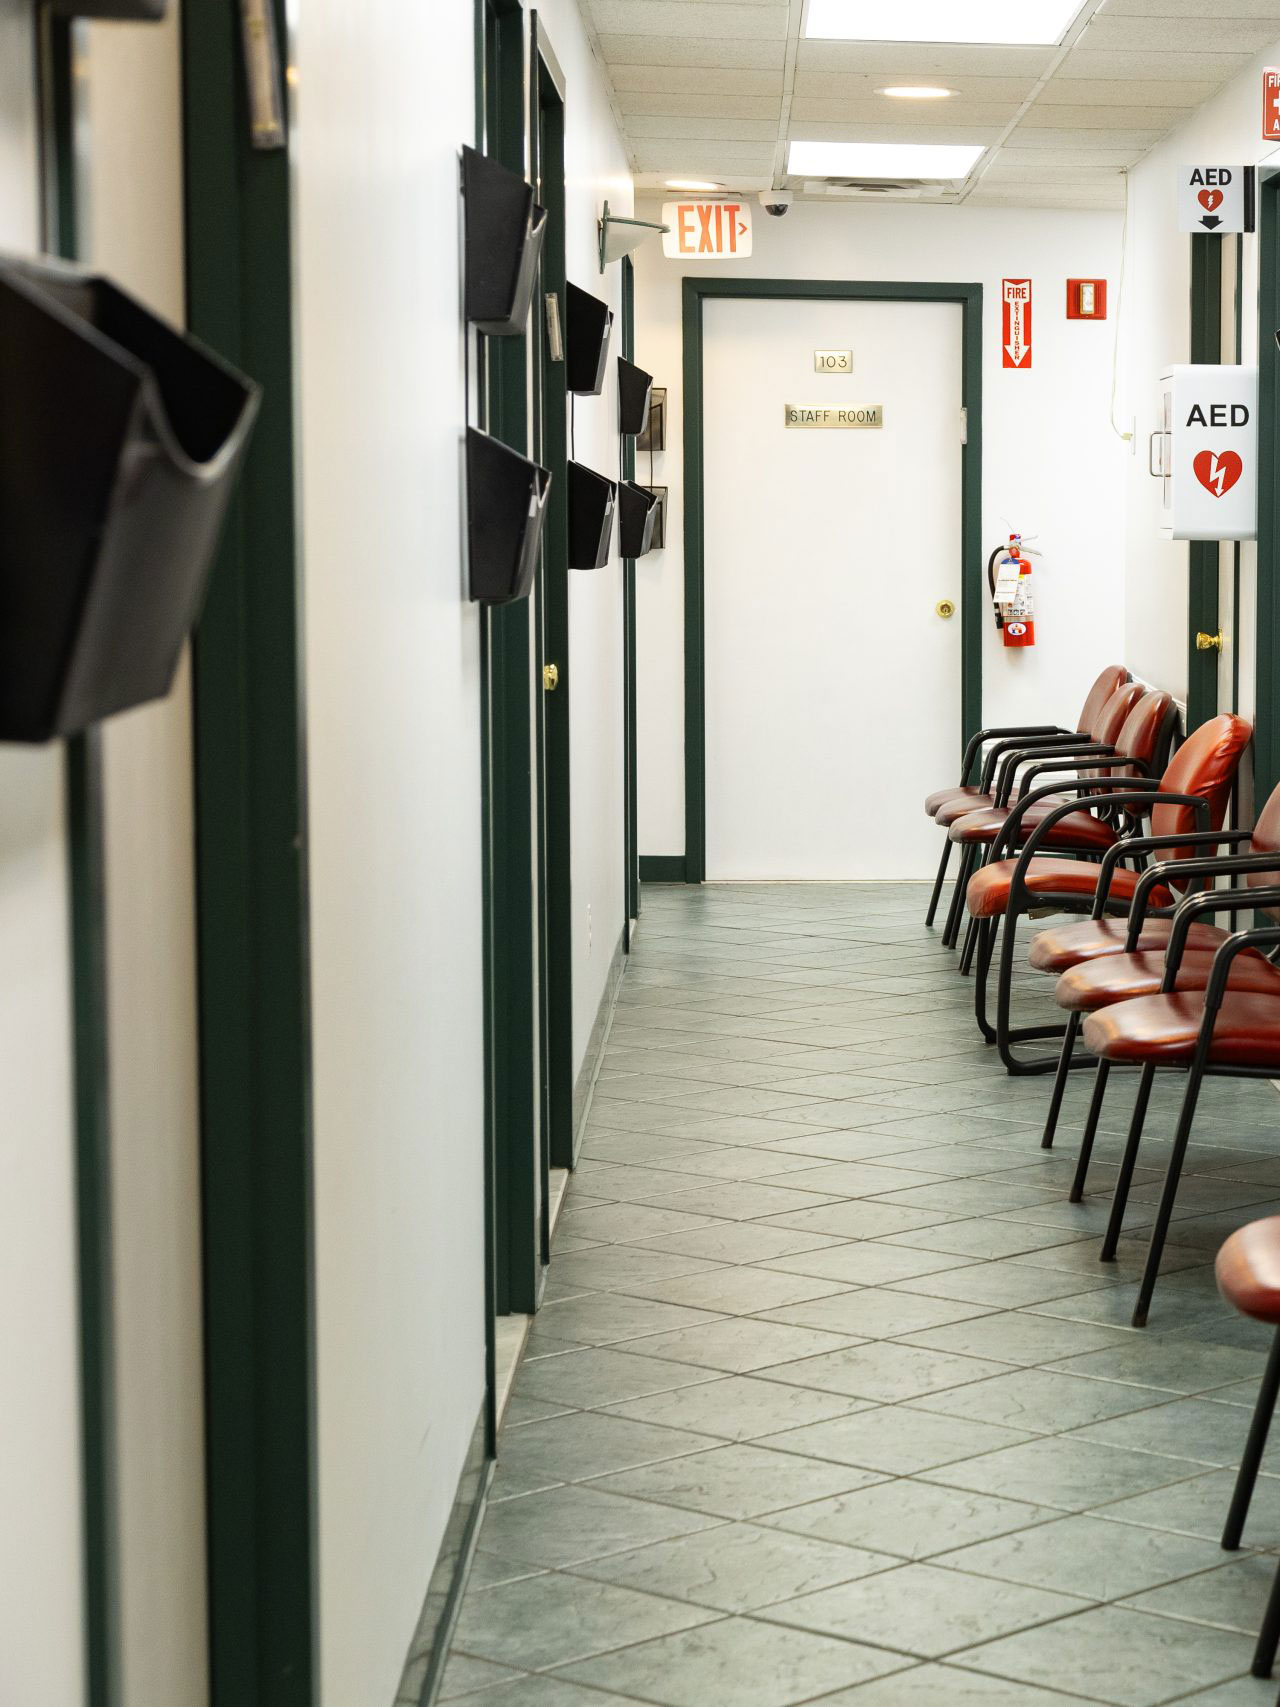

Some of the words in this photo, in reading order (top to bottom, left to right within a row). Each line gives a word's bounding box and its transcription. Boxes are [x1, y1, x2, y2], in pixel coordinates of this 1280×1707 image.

[1189, 168, 1233, 186] AED
[677, 204, 740, 253] EXIT
[1007, 287, 1027, 299] FIRE
[820, 355, 848, 368] 103
[790, 409, 831, 423] STAFF
[838, 410, 876, 423] ROOM
[1185, 404, 1250, 427] AED
